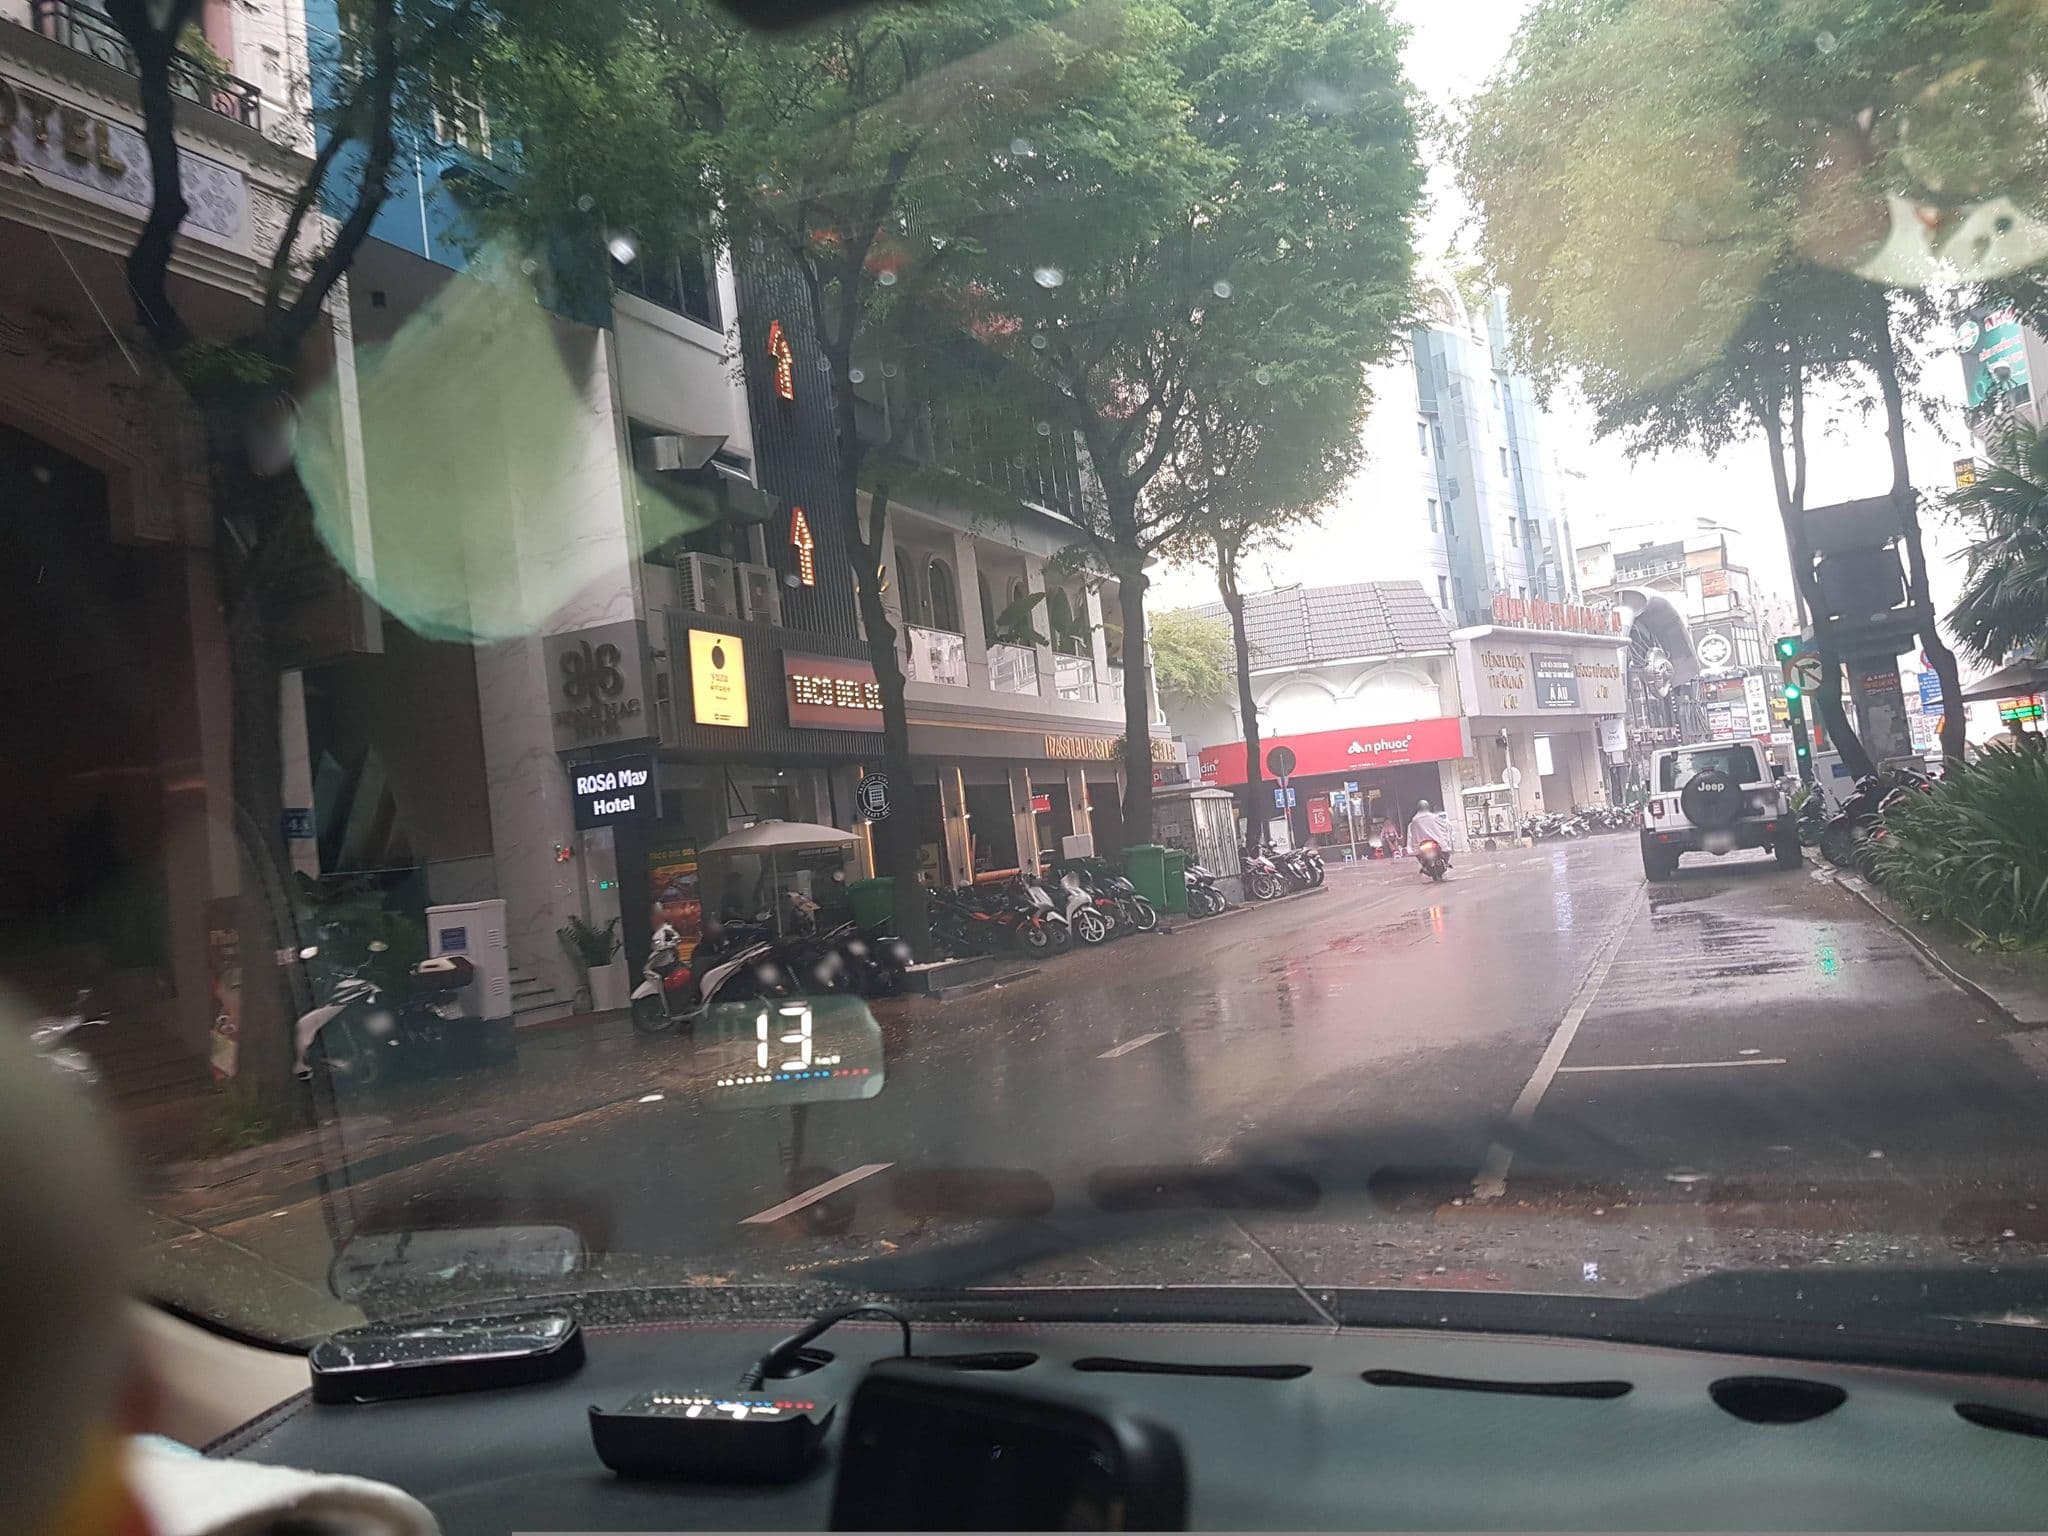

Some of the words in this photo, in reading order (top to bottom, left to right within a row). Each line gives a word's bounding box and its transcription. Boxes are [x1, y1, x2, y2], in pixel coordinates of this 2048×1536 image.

[793, 675, 833, 706] TACO
[835, 679, 864, 708] DEL
[1201, 762, 1216, 774] din
[577, 773, 616, 795] ROSA
[618, 769, 648, 789] May
[1697, 781, 1725, 792] Jeep
[593, 795, 635, 815] Hotel
[757, 1006, 813, 1071] 13
